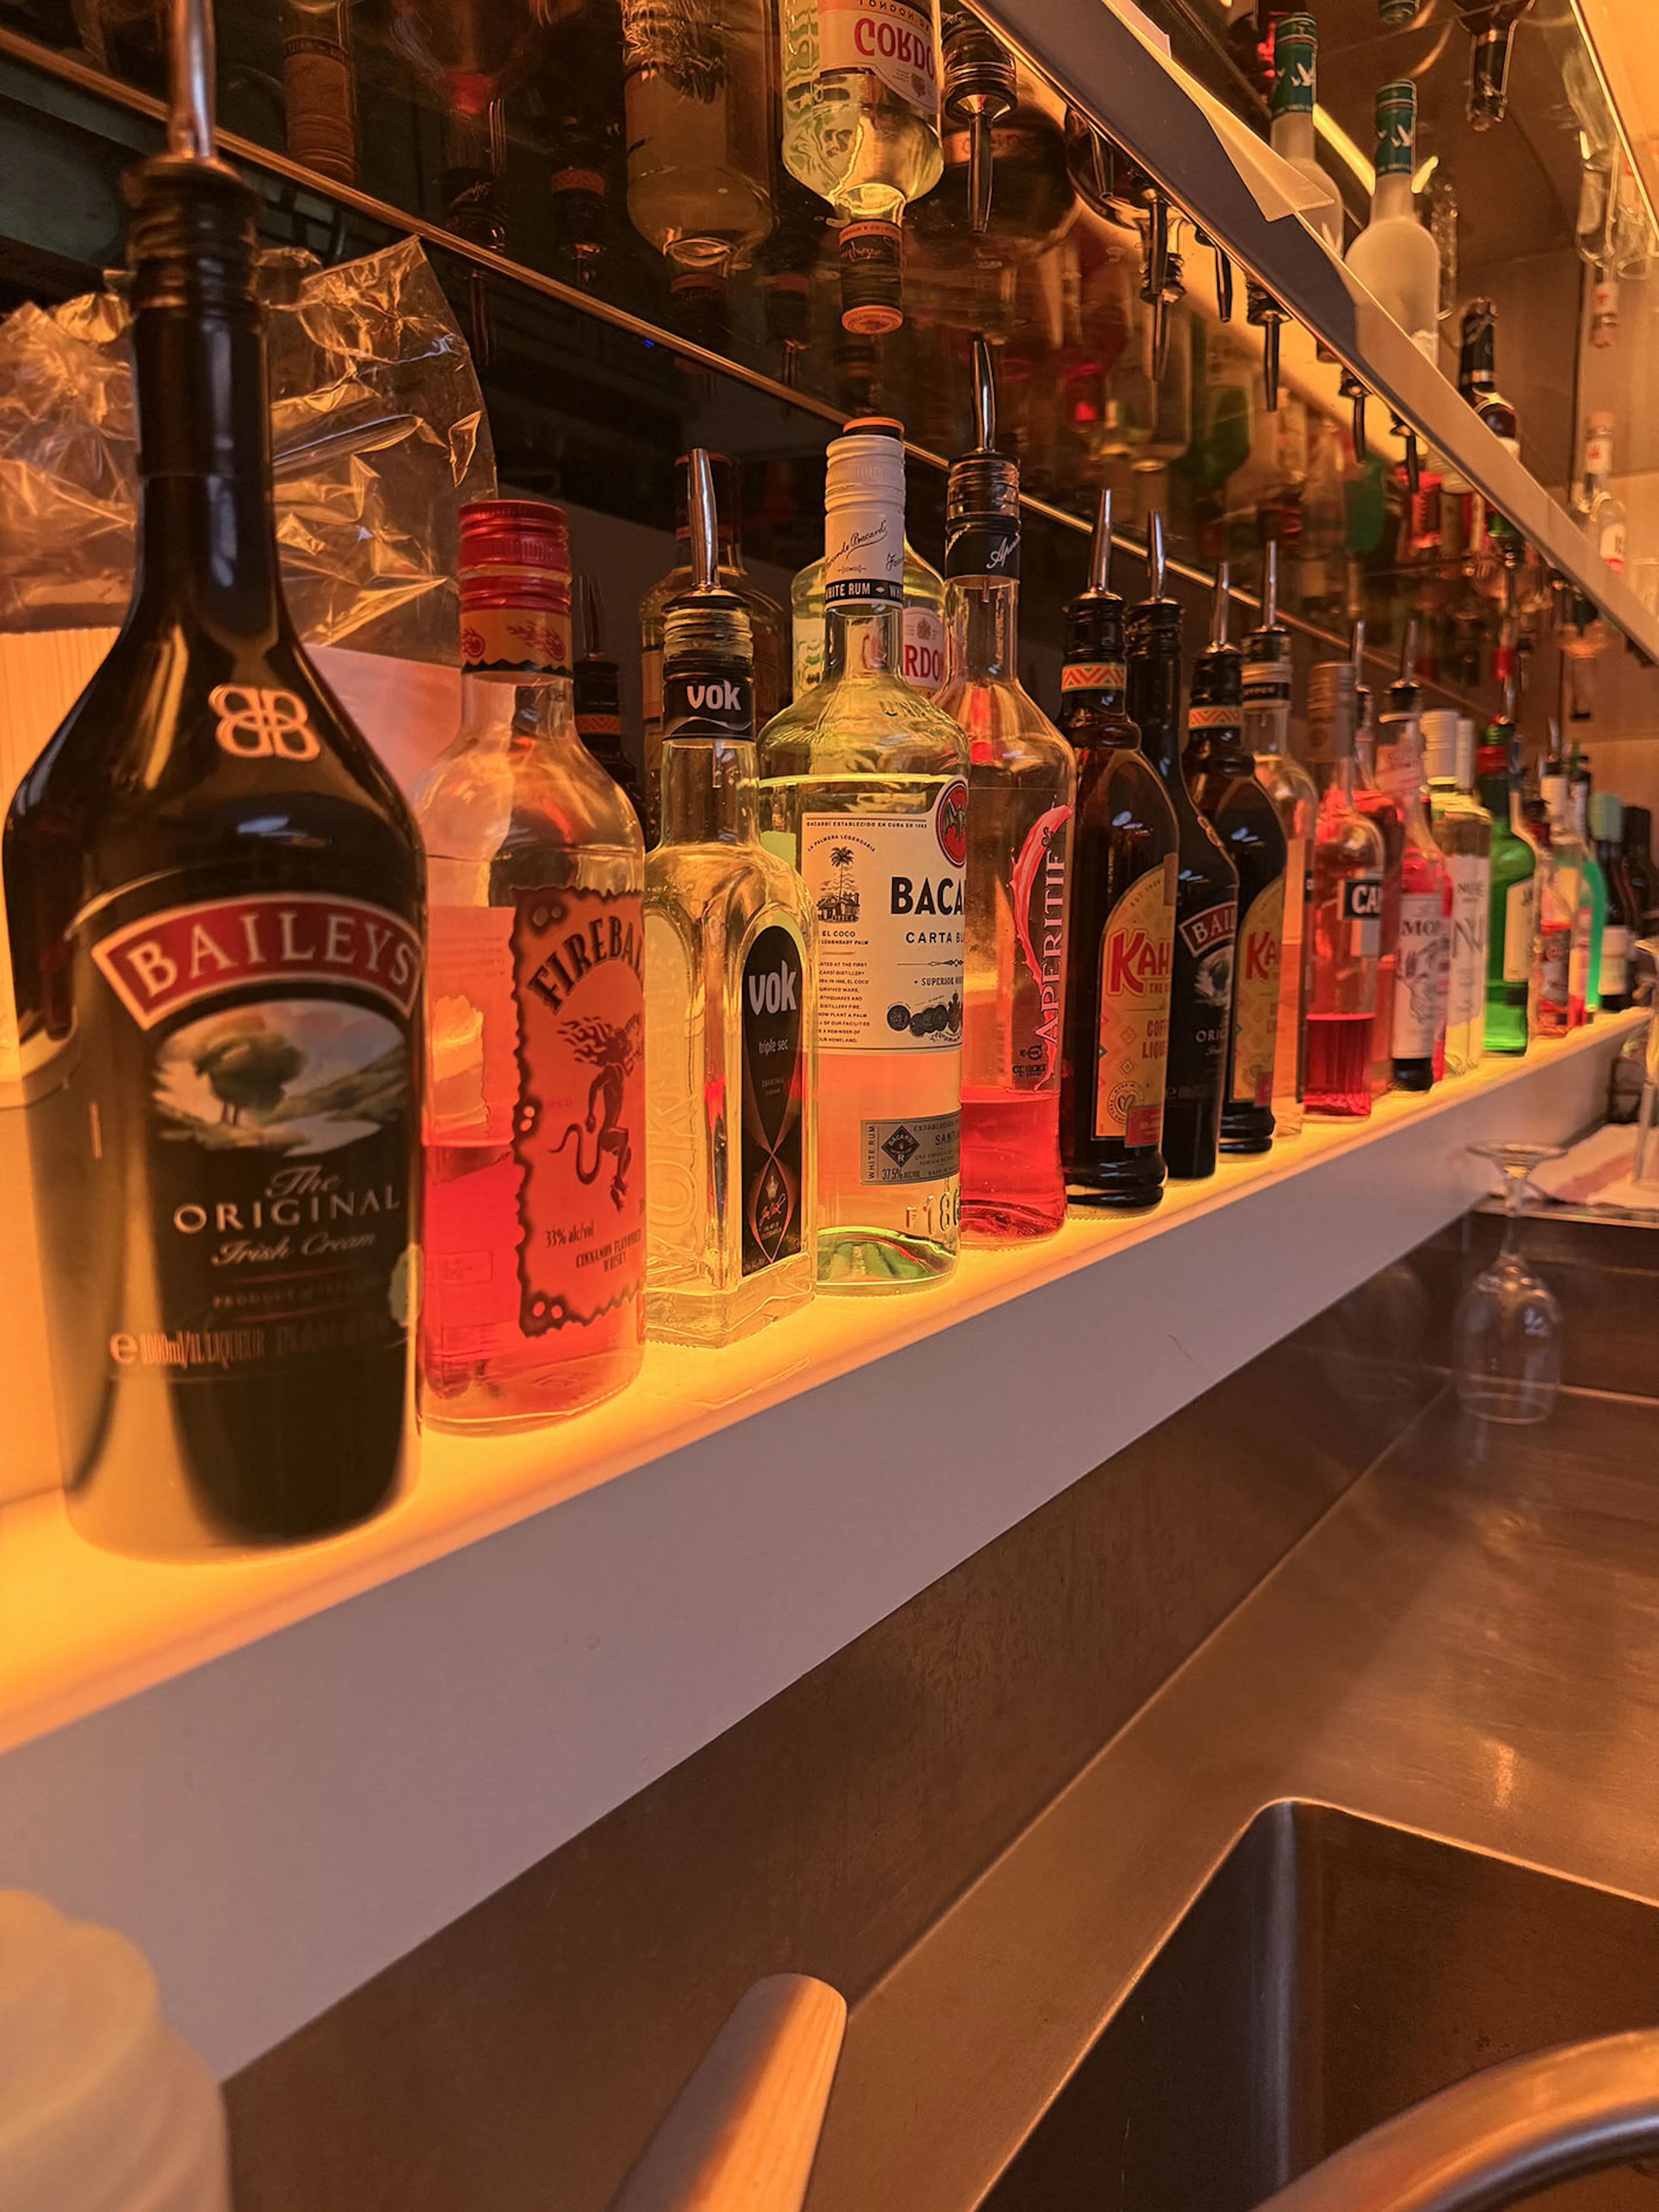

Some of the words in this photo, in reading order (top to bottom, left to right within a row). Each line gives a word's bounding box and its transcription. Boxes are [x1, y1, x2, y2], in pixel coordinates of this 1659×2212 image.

[848, 582, 871, 595] RUM
[840, 835, 876, 853] LEGENDARIA
[890, 877, 966, 915] BACA
[126, 910, 414, 997] BAILEYS
[906, 932, 952, 944] CARTA
[1035, 850, 1065, 1043] APERITIF
[1245, 930, 1281, 981] KA
[758, 1038, 777, 1056] triple
[778, 1038, 788, 1051] sec
[935, 1130, 960, 1146] SANT
[264, 1165, 341, 1197] The
[174, 1184, 401, 1235] ORIGINAL
[211, 1236, 290, 1266] Irish
[301, 1232, 376, 1257] Cream
[546, 1228, 567, 1249] 33%
